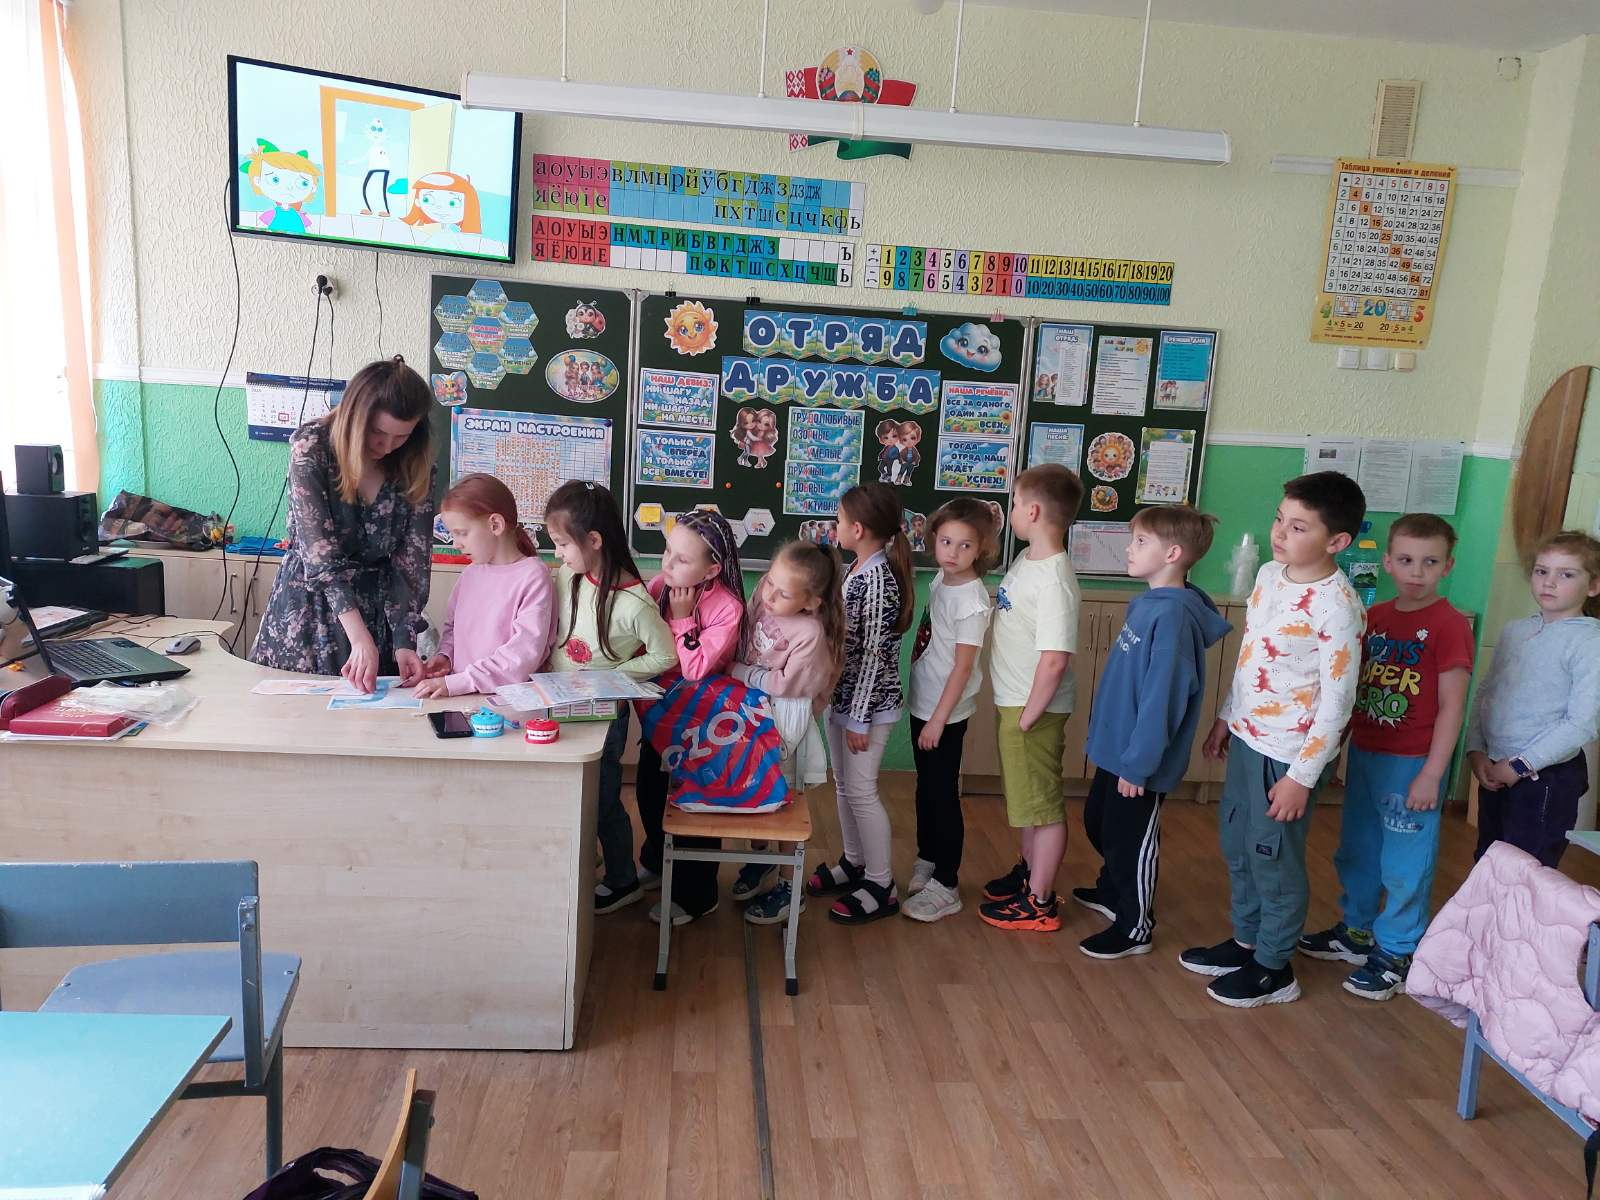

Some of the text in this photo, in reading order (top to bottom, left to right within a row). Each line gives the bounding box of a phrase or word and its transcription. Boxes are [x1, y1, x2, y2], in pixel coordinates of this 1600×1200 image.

[1354, 177, 1361, 185] 2
[1378, 179, 1384, 187] 4
[1391, 180, 1397, 188] 5
[1403, 180, 1408, 188] 6
[1415, 182, 1422, 190] 7
[1427, 183, 1433, 191] 8
[1439, 183, 1445, 191] 9
[1341, 189, 1346, 197] 2
[1377, 192, 1382, 200] 8
[1388, 193, 1397, 201] 10
[1401, 194, 1409, 202] 12
[1412, 195, 1420, 203] 14
[1424, 196, 1433, 204] 16
[1409, 208, 1418, 216] 21
[1421, 209, 1431, 217] 24
[1433, 210, 1443, 218] 27
[1337, 216, 1342, 224] 4
[1360, 218, 1368, 226] 12
[1372, 219, 1381, 227] 16
[1383, 220, 1393, 228] 20
[1407, 221, 1417, 229] 28
[1431, 223, 1440, 231] 36
[1335, 229, 1340, 237] 5
[1346, 230, 1355, 238] 10
[1369, 232, 1379, 240] 20
[1381, 233, 1391, 241] 25
[1393, 234, 1403, 242] 30
[1417, 236, 1427, 244] 40
[886, 249, 1172, 281] 1 2 3 4 5 6 7 8 9 10 11 12 13 14 15 16 17 18 19 20
[884, 271, 1170, 301] 9 8 7 6 5 4 3 2 1 0 10 20 30 40 50 60 70 80 90 100
[748, 317, 924, 358] ОТРЯД
[650, 375, 674, 384] НАШ
[724, 363, 933, 405] ДРУЖБА
[646, 385, 691, 396] НИ ШАГУ
[949, 387, 973, 395] НАША
[662, 404, 690, 413] ШАГУ
[793, 413, 860, 425] ТРУДОЛЮБИВЫЕ
[465, 418, 605, 439] ЭКРАН НАСТРОЕНИЯ
[793, 429, 829, 440] ОЗОРНЫЕ
[655, 437, 693, 446] ТОЛЬКО
[670, 447, 707, 458] ВПЕРЁД
[951, 453, 980, 461] ОТРЯД
[656, 457, 693, 466] ТОЛЬКО
[944, 462, 973, 473] ЖДЁТ
[664, 468, 708, 479] ВМЕСТЕ!
[967, 475, 1002, 484] УСПЕХ!
[793, 482, 825, 493] ДОБРЫЕ
[660, 695, 775, 771] OZON
